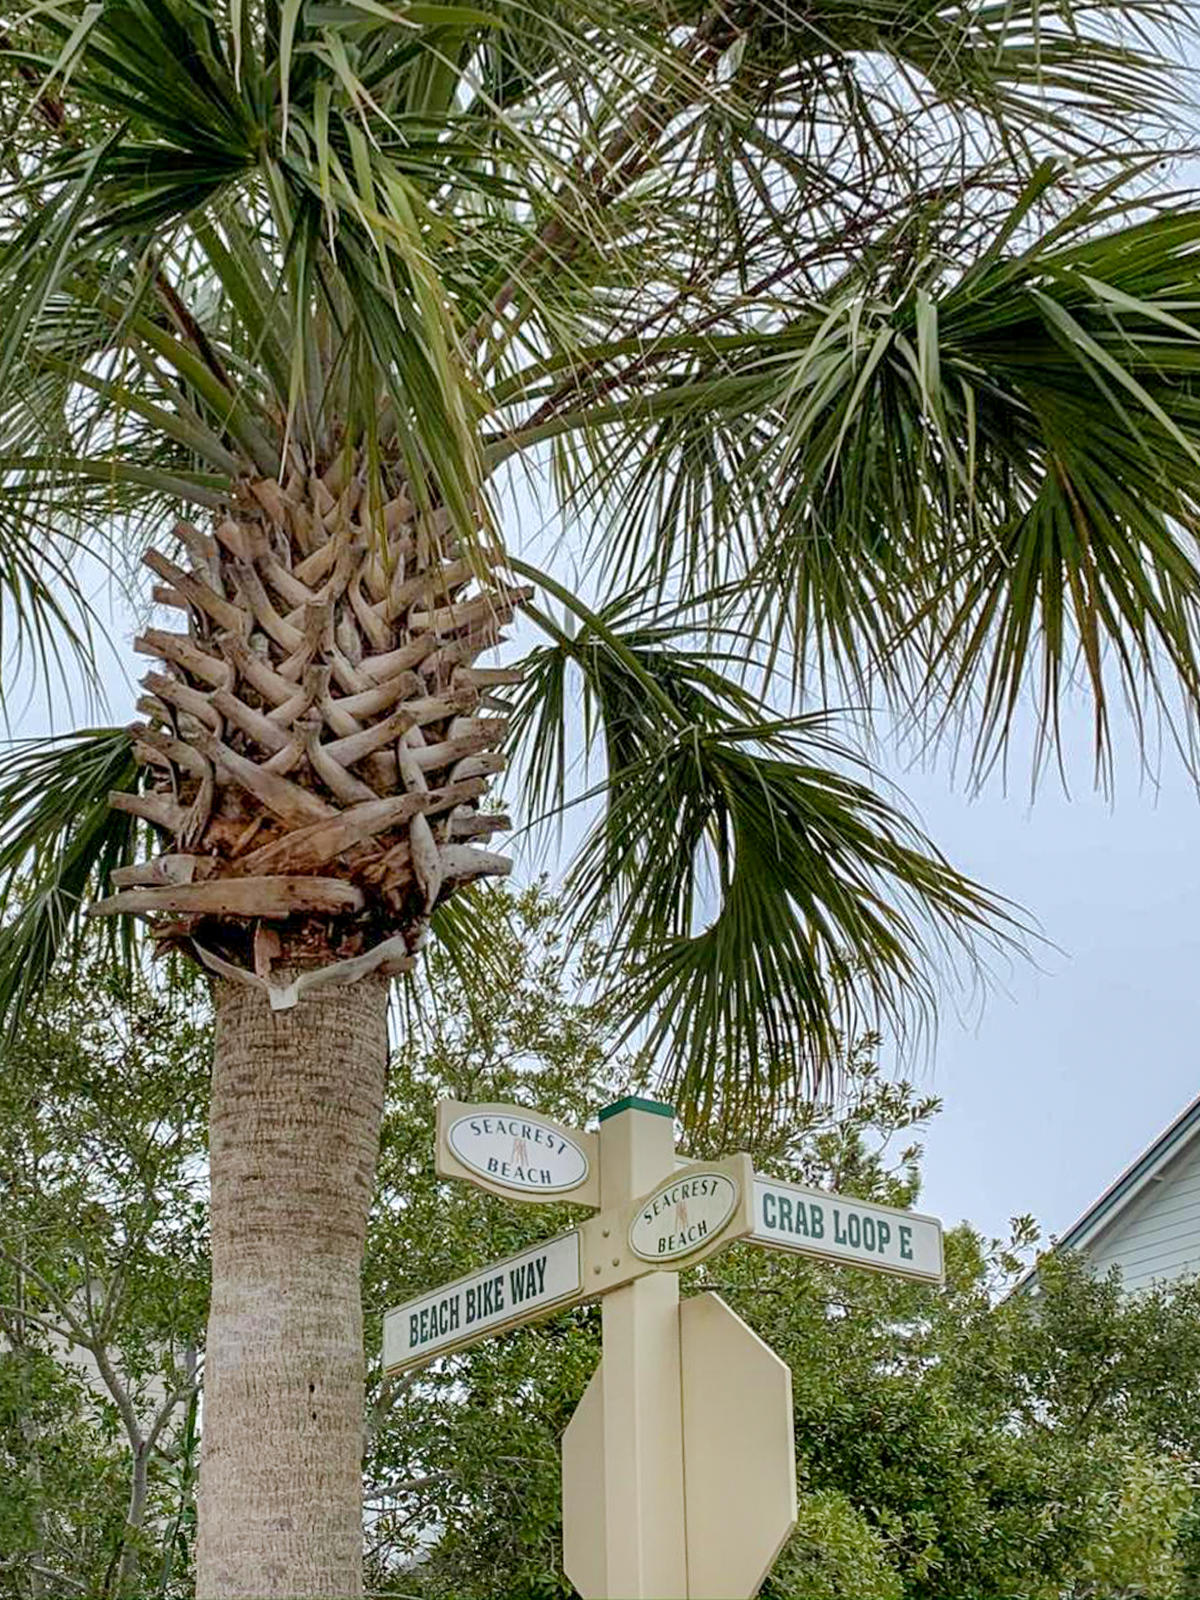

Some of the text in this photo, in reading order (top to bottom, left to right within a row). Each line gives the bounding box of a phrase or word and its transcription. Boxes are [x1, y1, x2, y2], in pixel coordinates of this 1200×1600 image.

[470, 1119, 567, 1155] SEACREST
[487, 1158, 552, 1184] BEACH
[643, 1179, 719, 1225] SEACREST
[657, 1220, 708, 1254] BEACH
[763, 1192, 913, 1260] CRAB LOOP E
[409, 1256, 547, 1348] BEACH BIKE WAY
